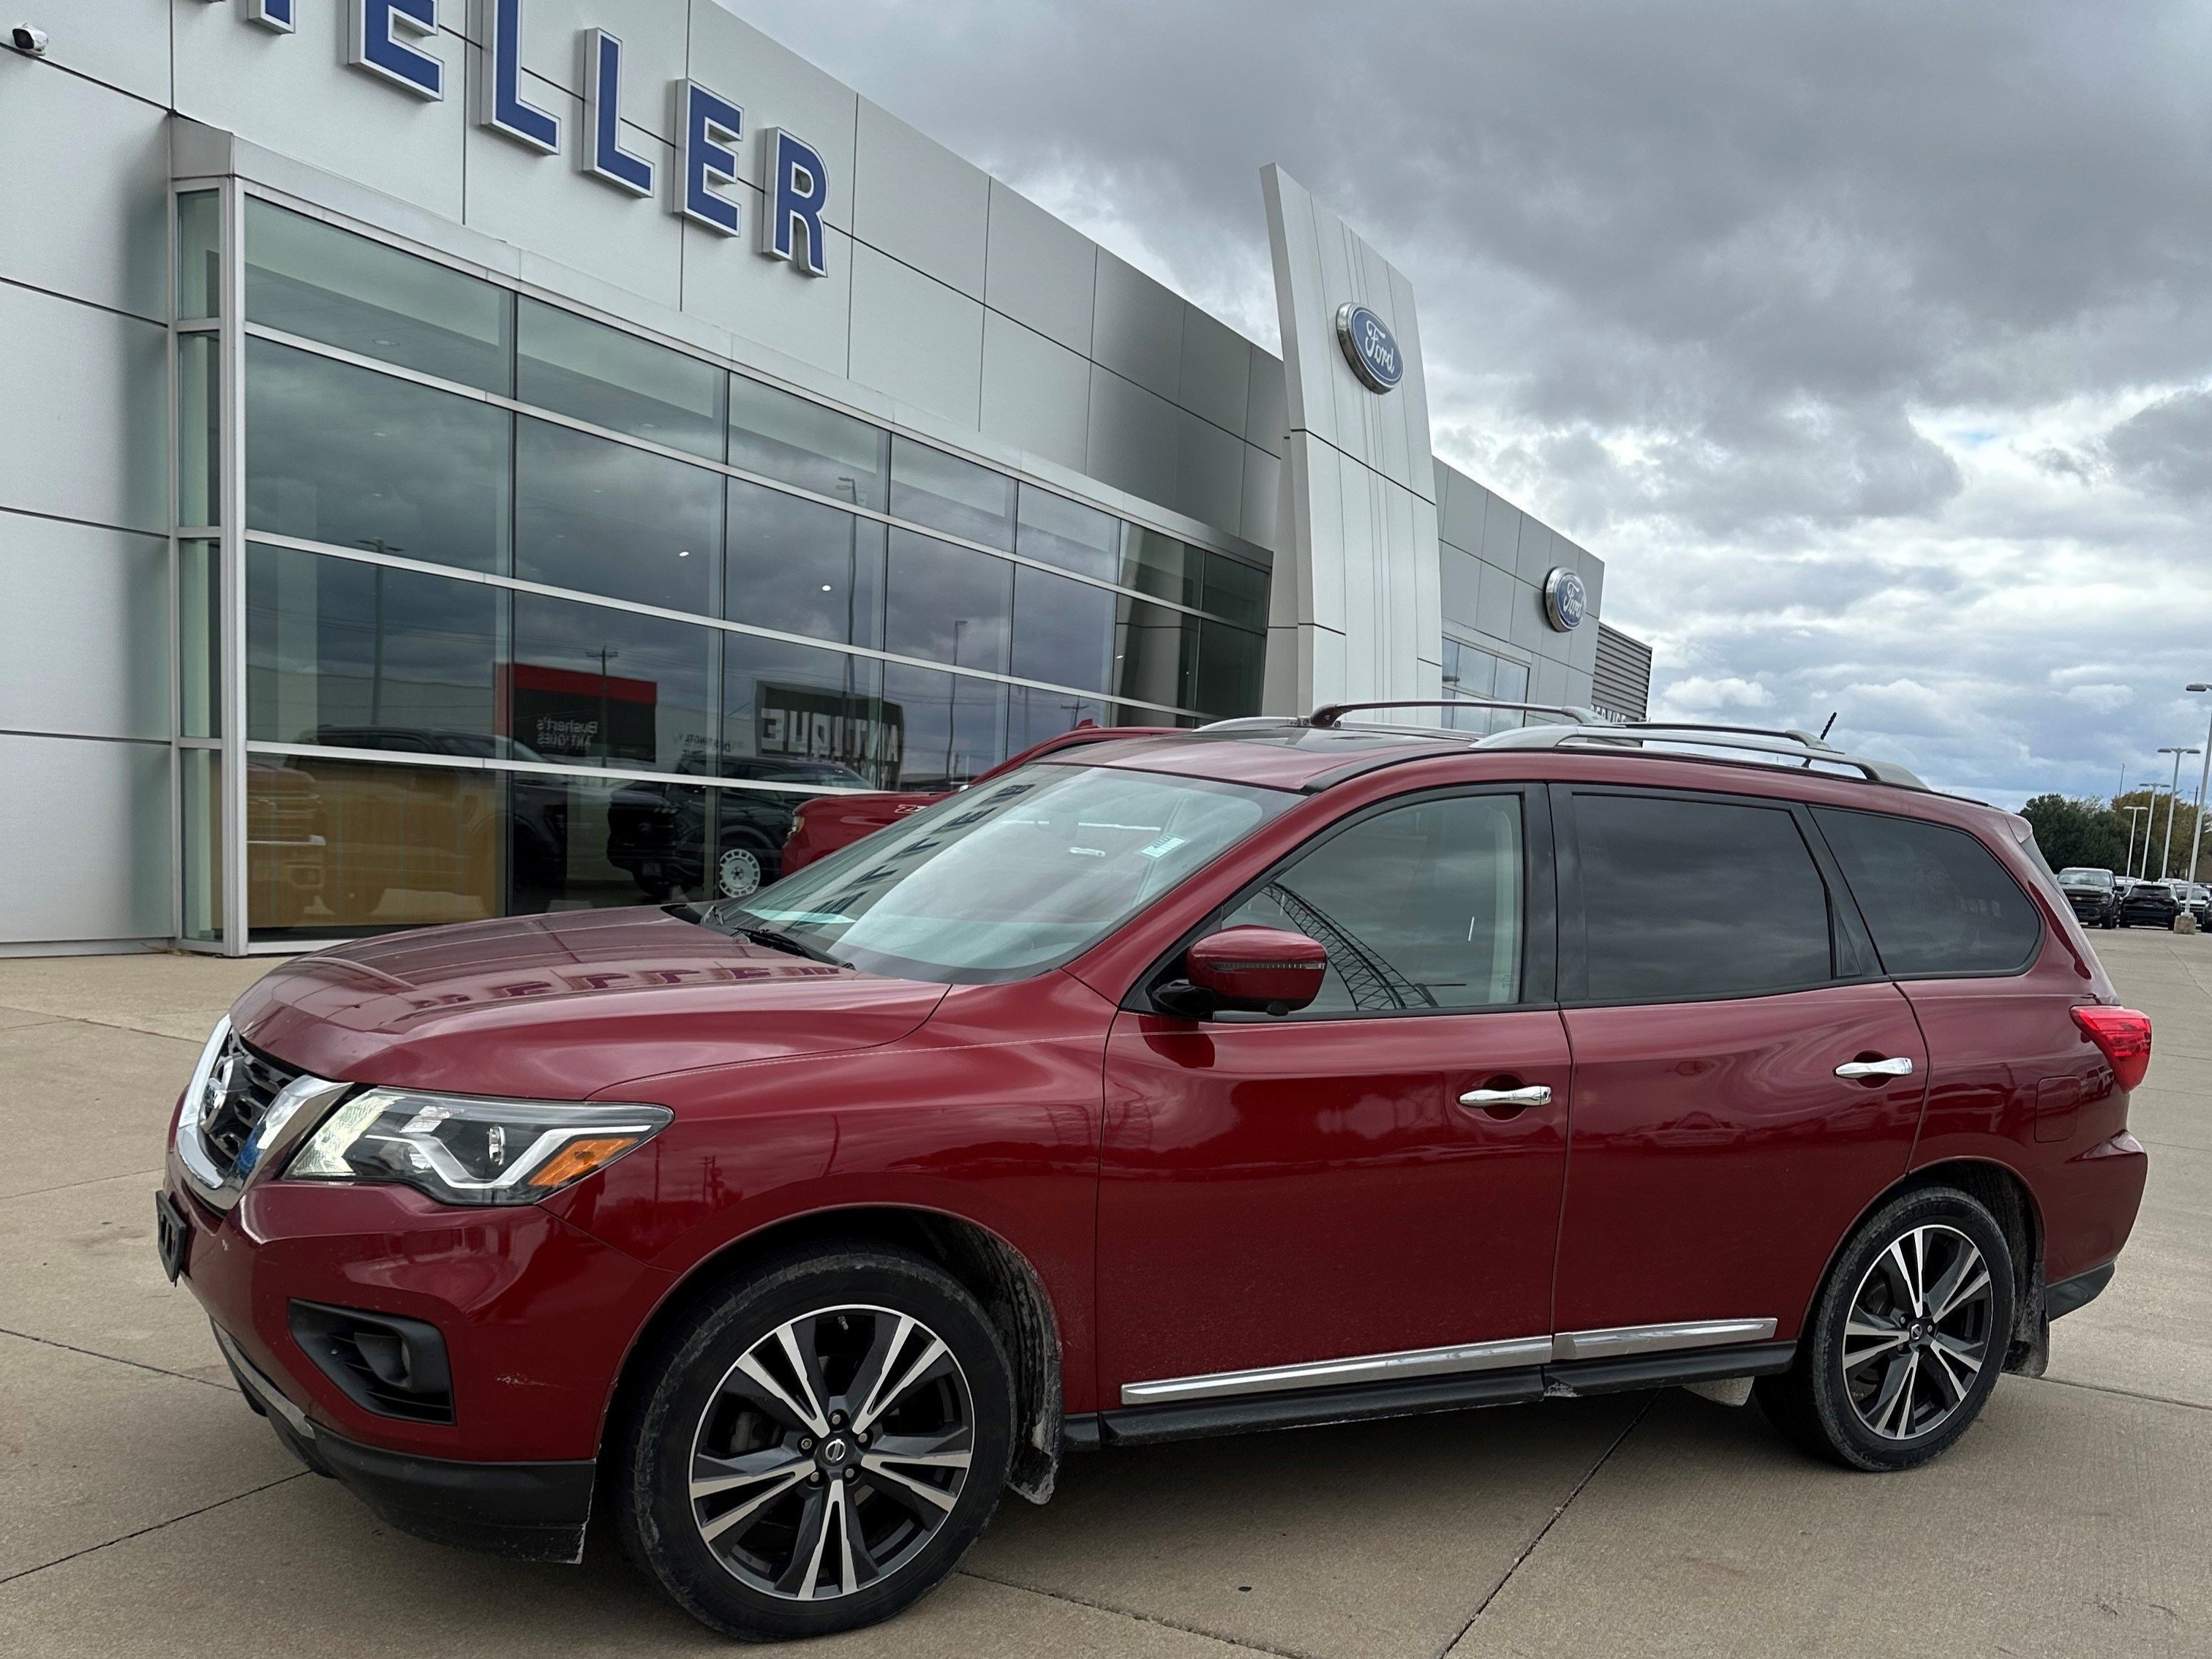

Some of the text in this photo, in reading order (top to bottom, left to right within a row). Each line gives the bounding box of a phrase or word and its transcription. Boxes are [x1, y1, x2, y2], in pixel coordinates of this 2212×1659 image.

[247, 0, 829, 278] ELLER
[1365, 320, 1395, 375] Ford
[1563, 582, 1585, 619] Ford
